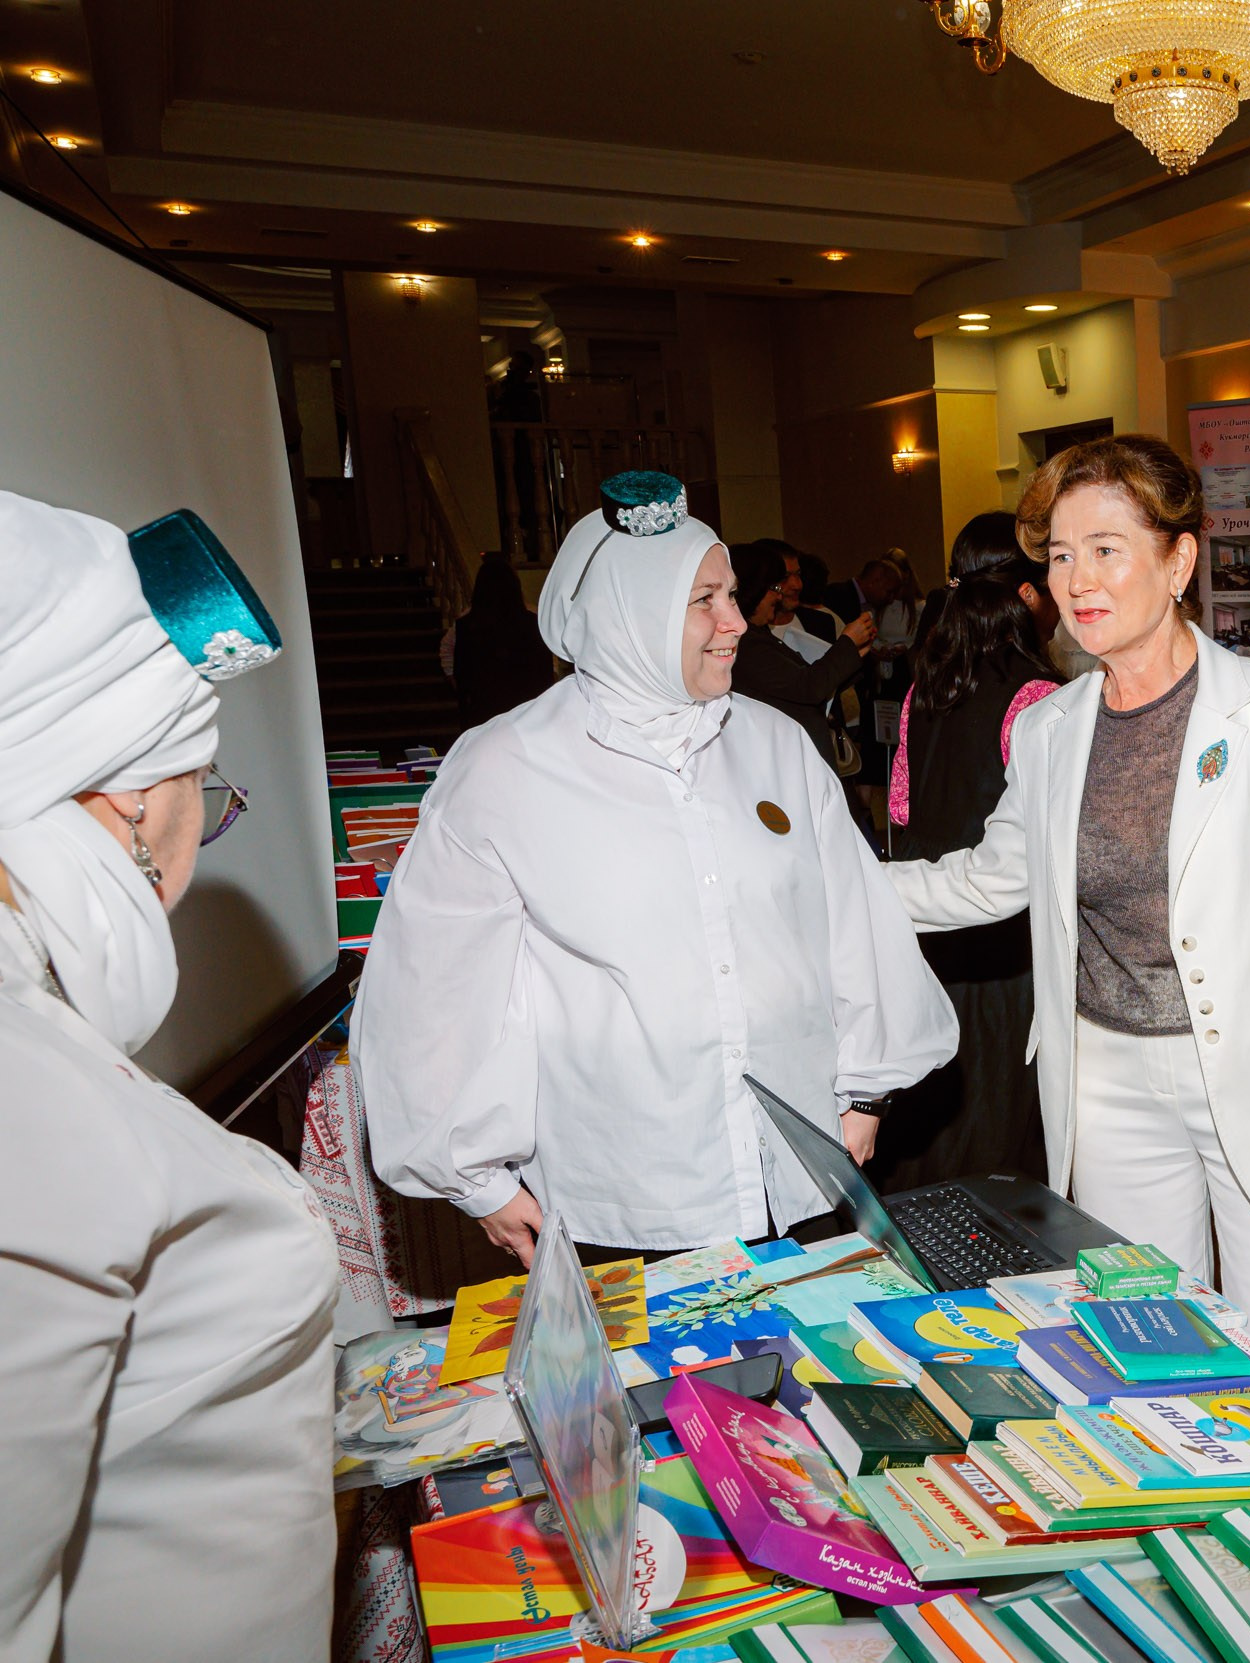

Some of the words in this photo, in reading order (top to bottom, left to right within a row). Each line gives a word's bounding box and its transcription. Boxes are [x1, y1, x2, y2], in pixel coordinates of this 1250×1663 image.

[932, 1298, 970, 1326] теле
[960, 1323, 1020, 1353] Татар
[1034, 1434, 1087, 1477] МИНЕМ
[1044, 1424, 1121, 1487] УЕНЧЫКЛАРЫМ
[1147, 1402, 1243, 1465] КОШЛАР
[951, 1461, 1012, 1506] КЕШЕ
[998, 1443, 1075, 1512] ХАЙВАННАР
[915, 1476, 990, 1541] ХАЙВАННАР
[506, 1545, 536, 1579] уены
[818, 1543, 865, 1574] Казан
